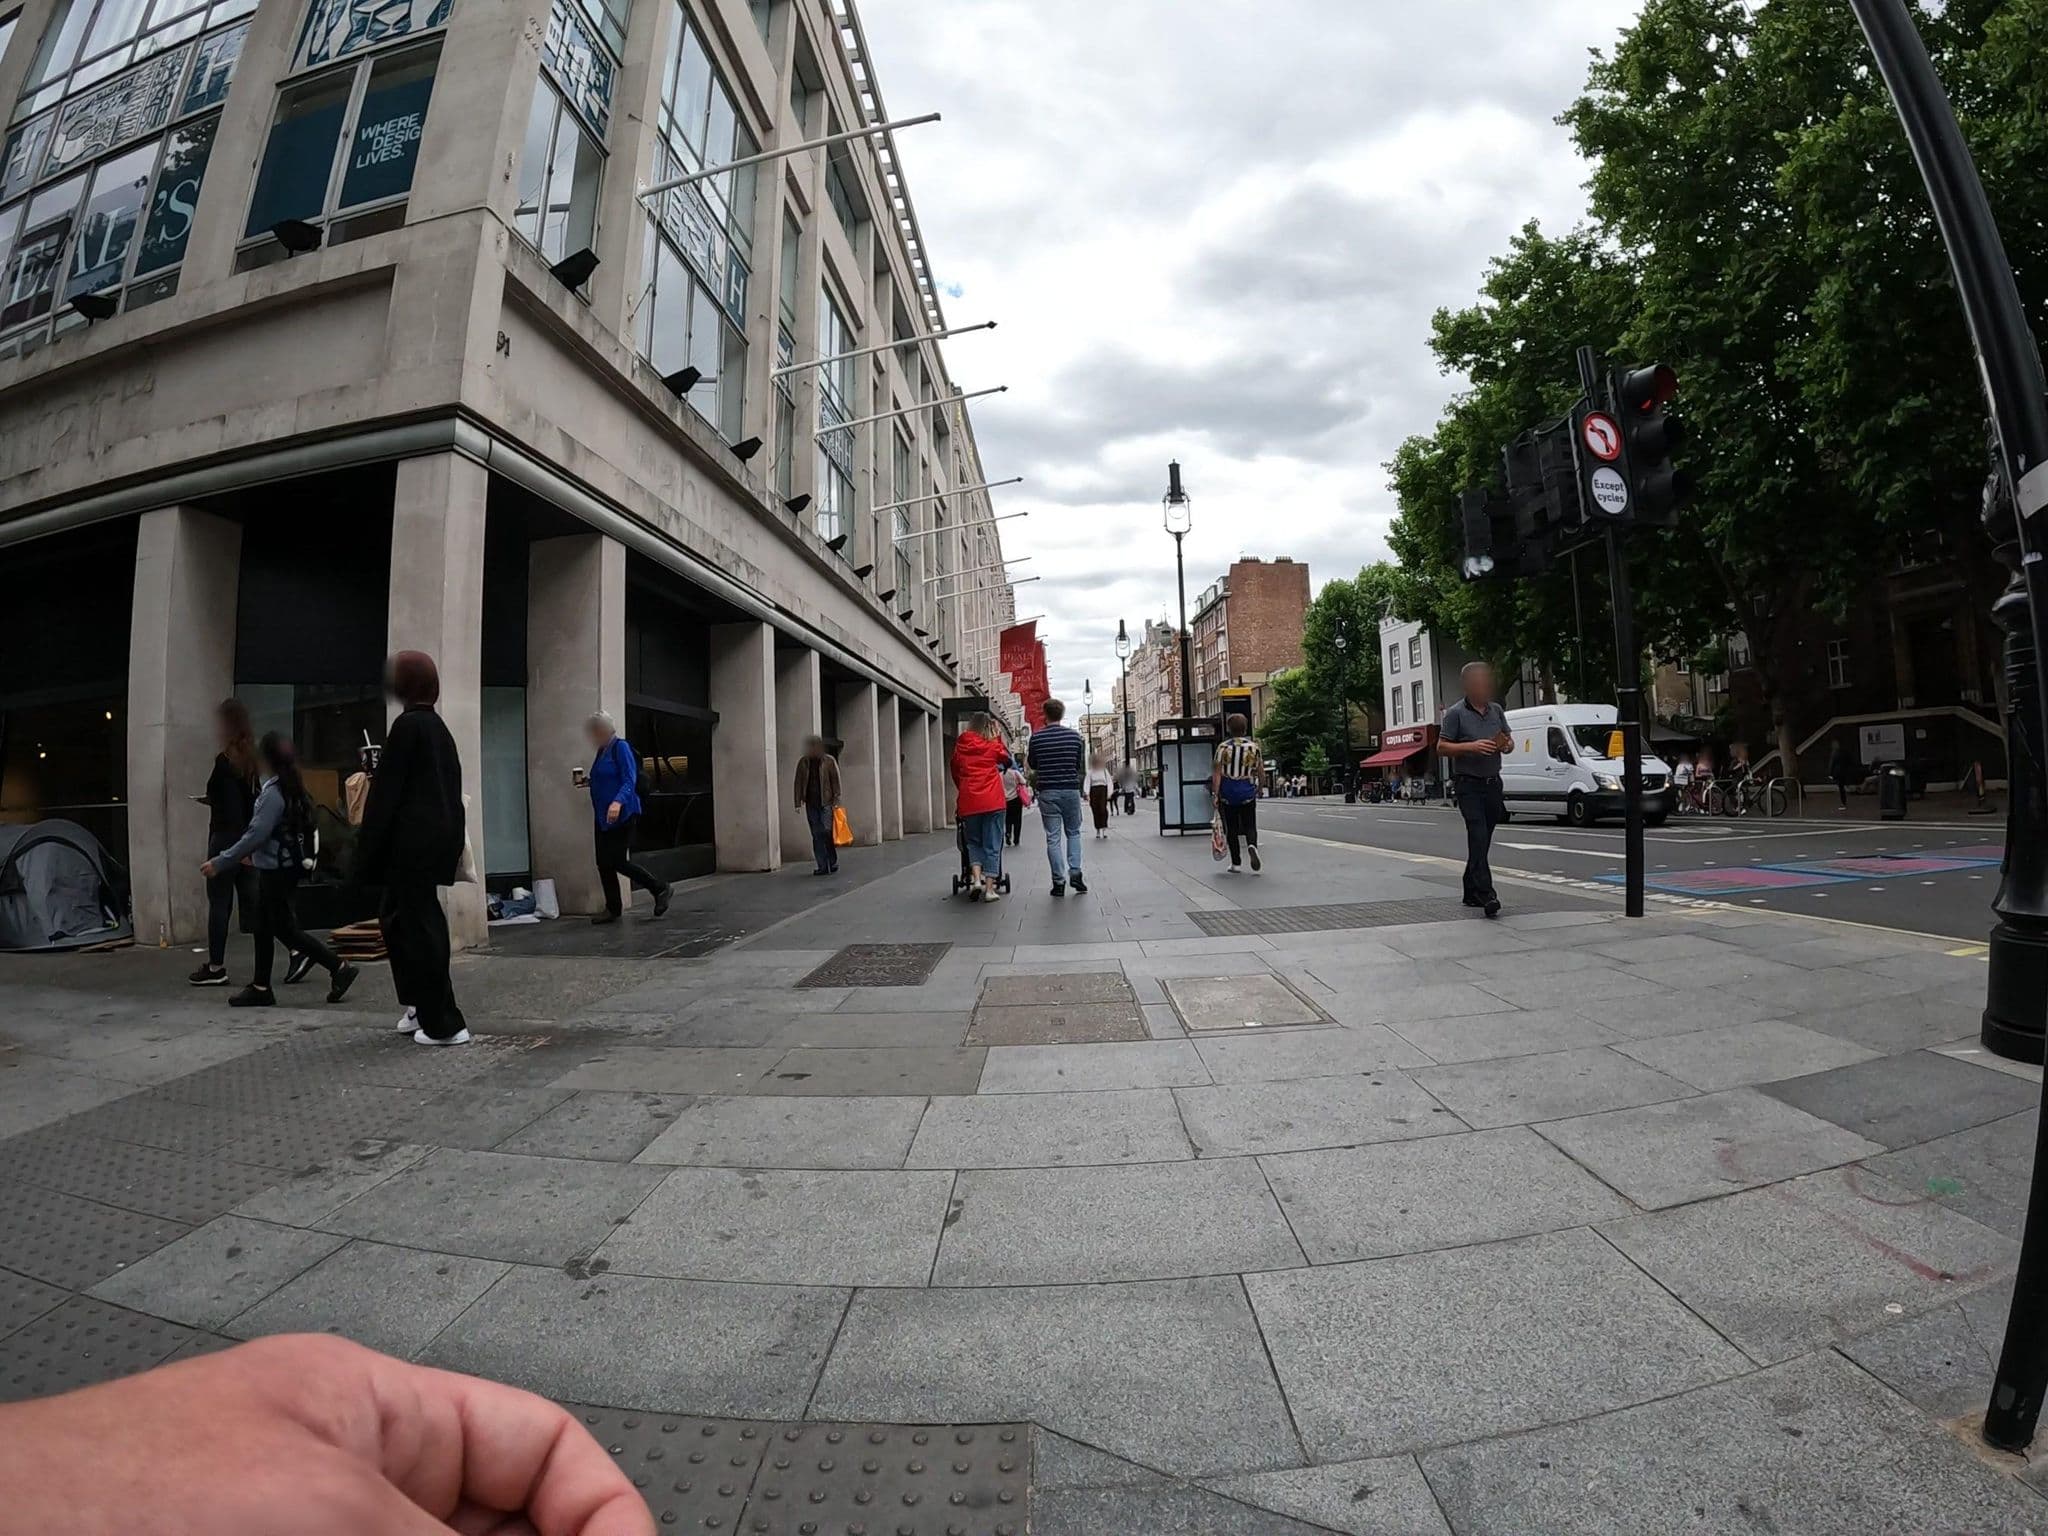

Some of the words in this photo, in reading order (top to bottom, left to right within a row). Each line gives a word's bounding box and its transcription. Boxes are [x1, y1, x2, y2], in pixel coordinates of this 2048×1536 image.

[361, 112, 420, 140] WHERE
[372, 126, 421, 151] DESIG
[356, 144, 405, 168] LIVES.
[1594, 479, 1625, 492] Except
[1598, 493, 1625, 503] cycles
[1386, 735, 1402, 745] COSTA
